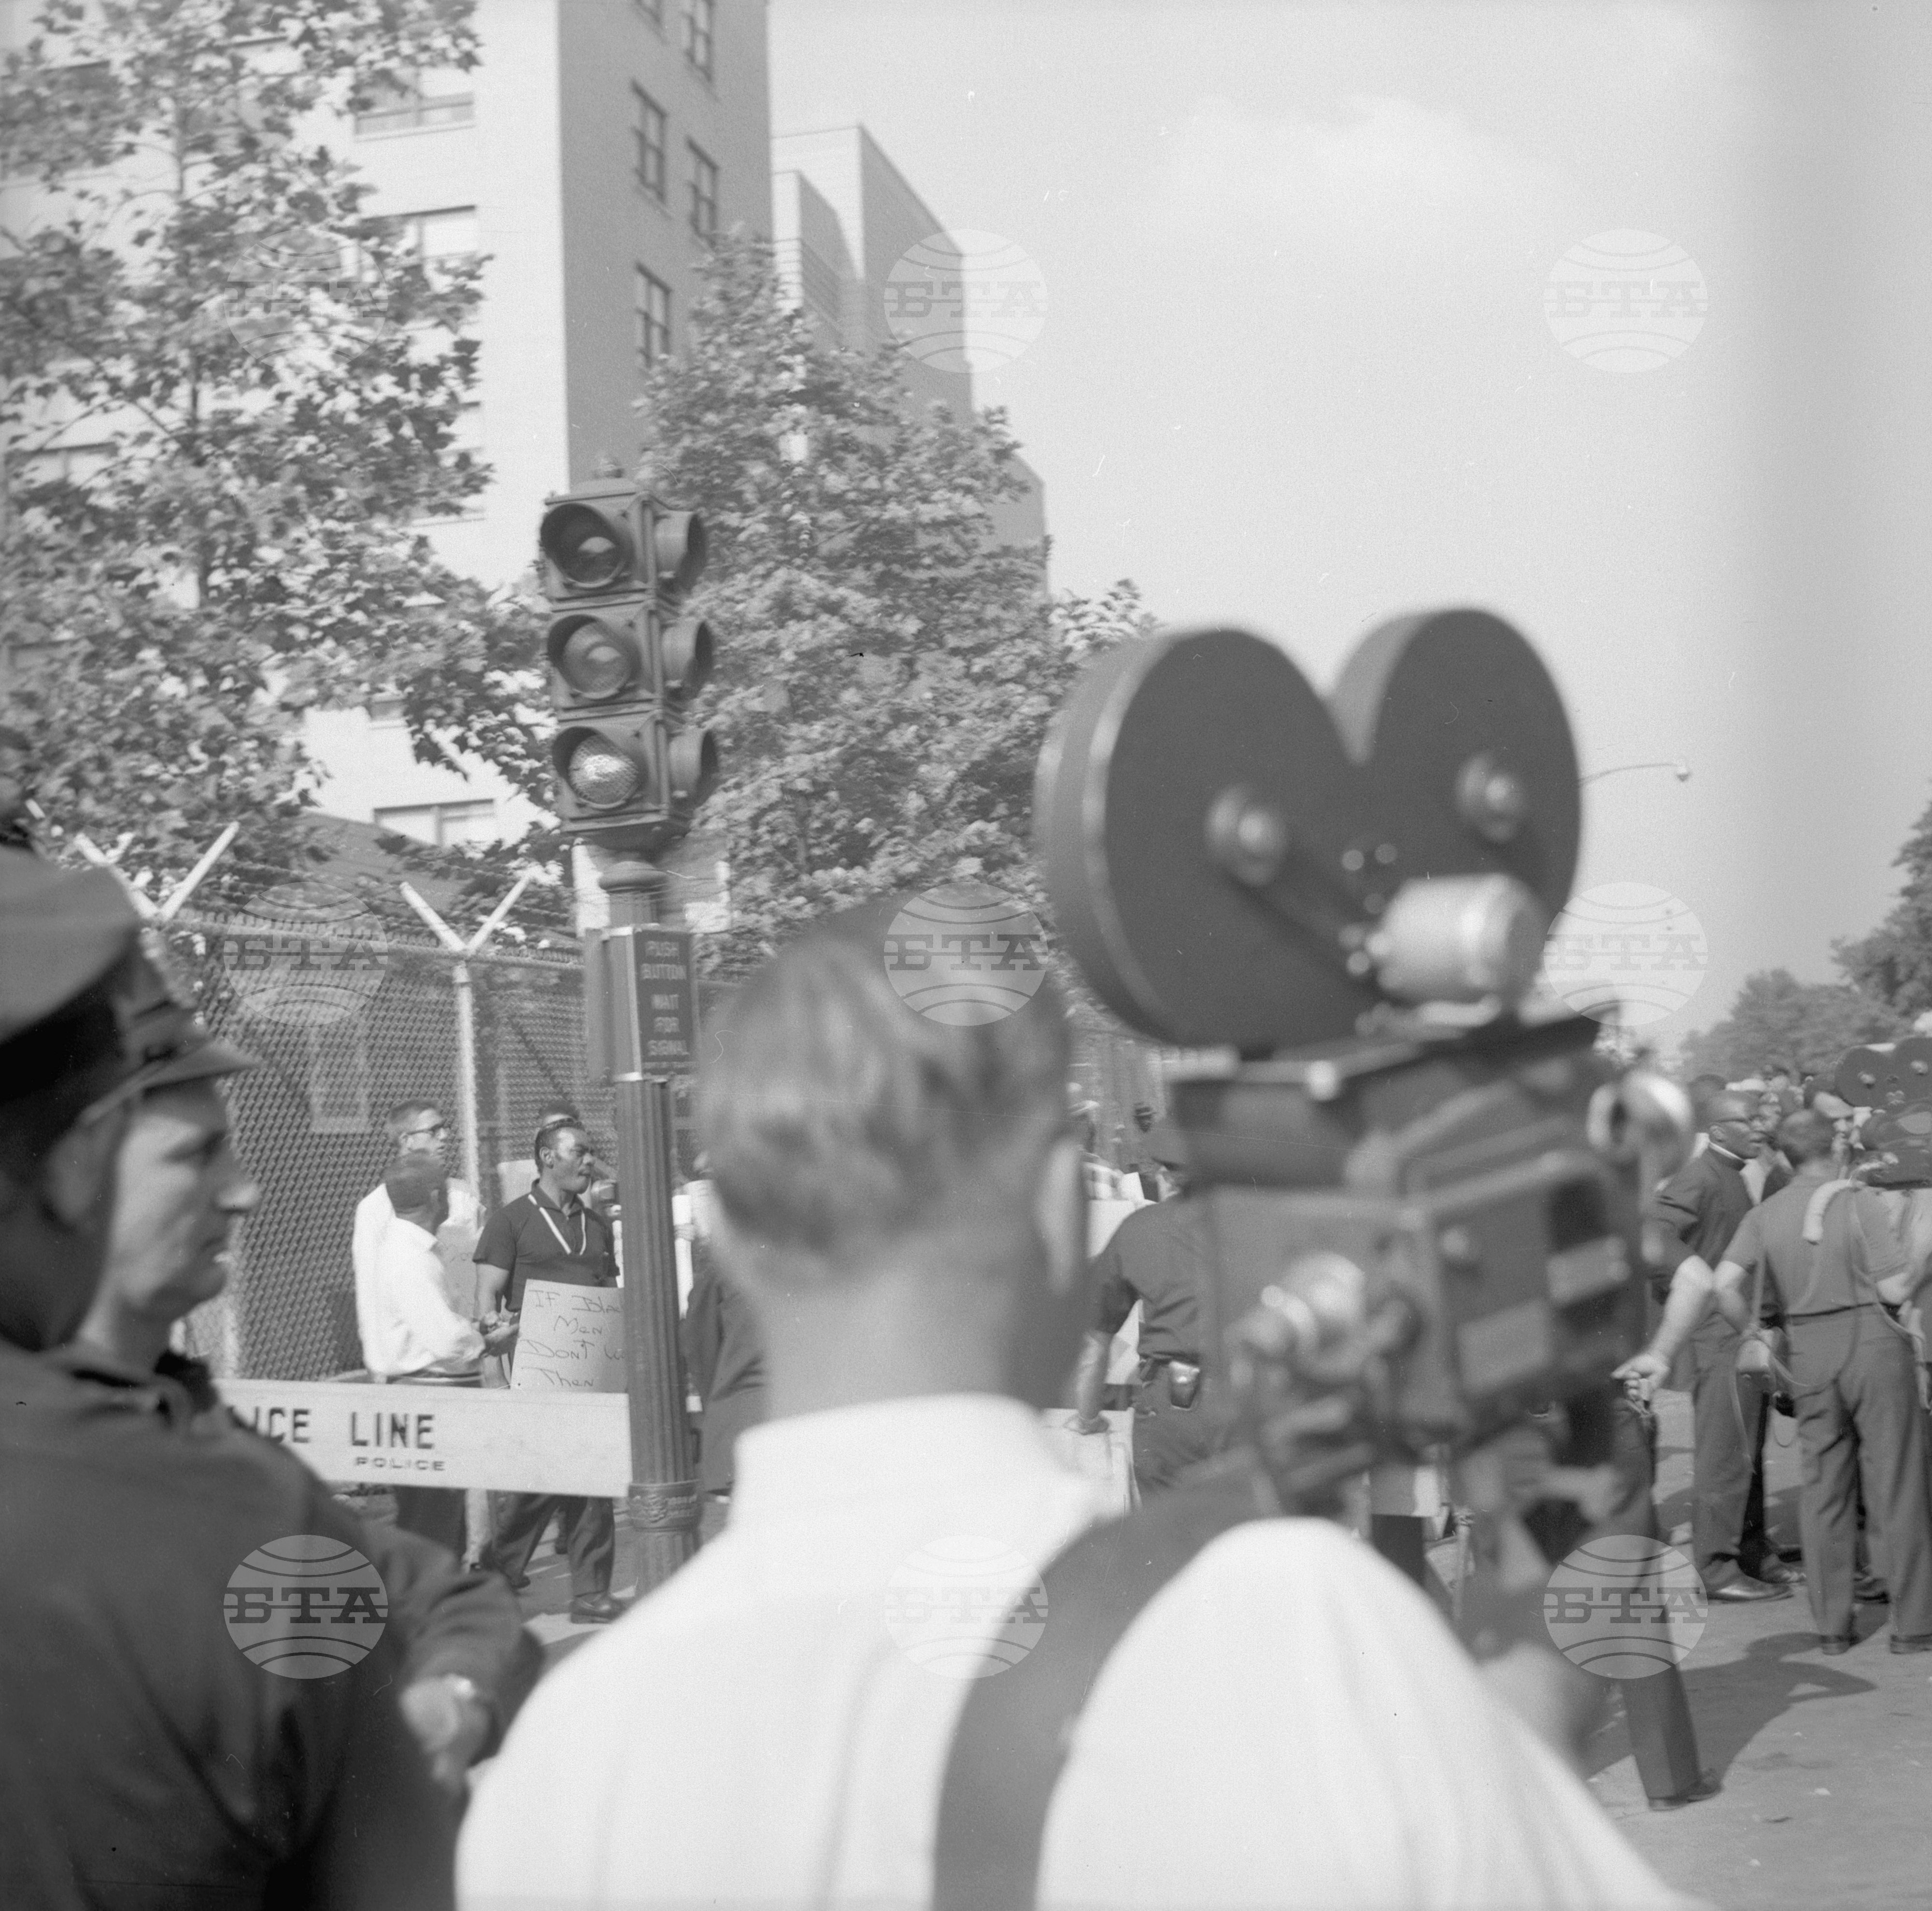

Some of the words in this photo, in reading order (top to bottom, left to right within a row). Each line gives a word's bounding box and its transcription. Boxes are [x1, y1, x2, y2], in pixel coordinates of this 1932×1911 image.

[640, 963, 687, 980] BUTTON
[651, 993, 680, 1010] WAIT
[653, 1017, 680, 1033] FOR
[647, 1039, 689, 1056] SIGNAL
[351, 1411, 435, 1450] LINE
[355, 1456, 445, 1472] POLICE
